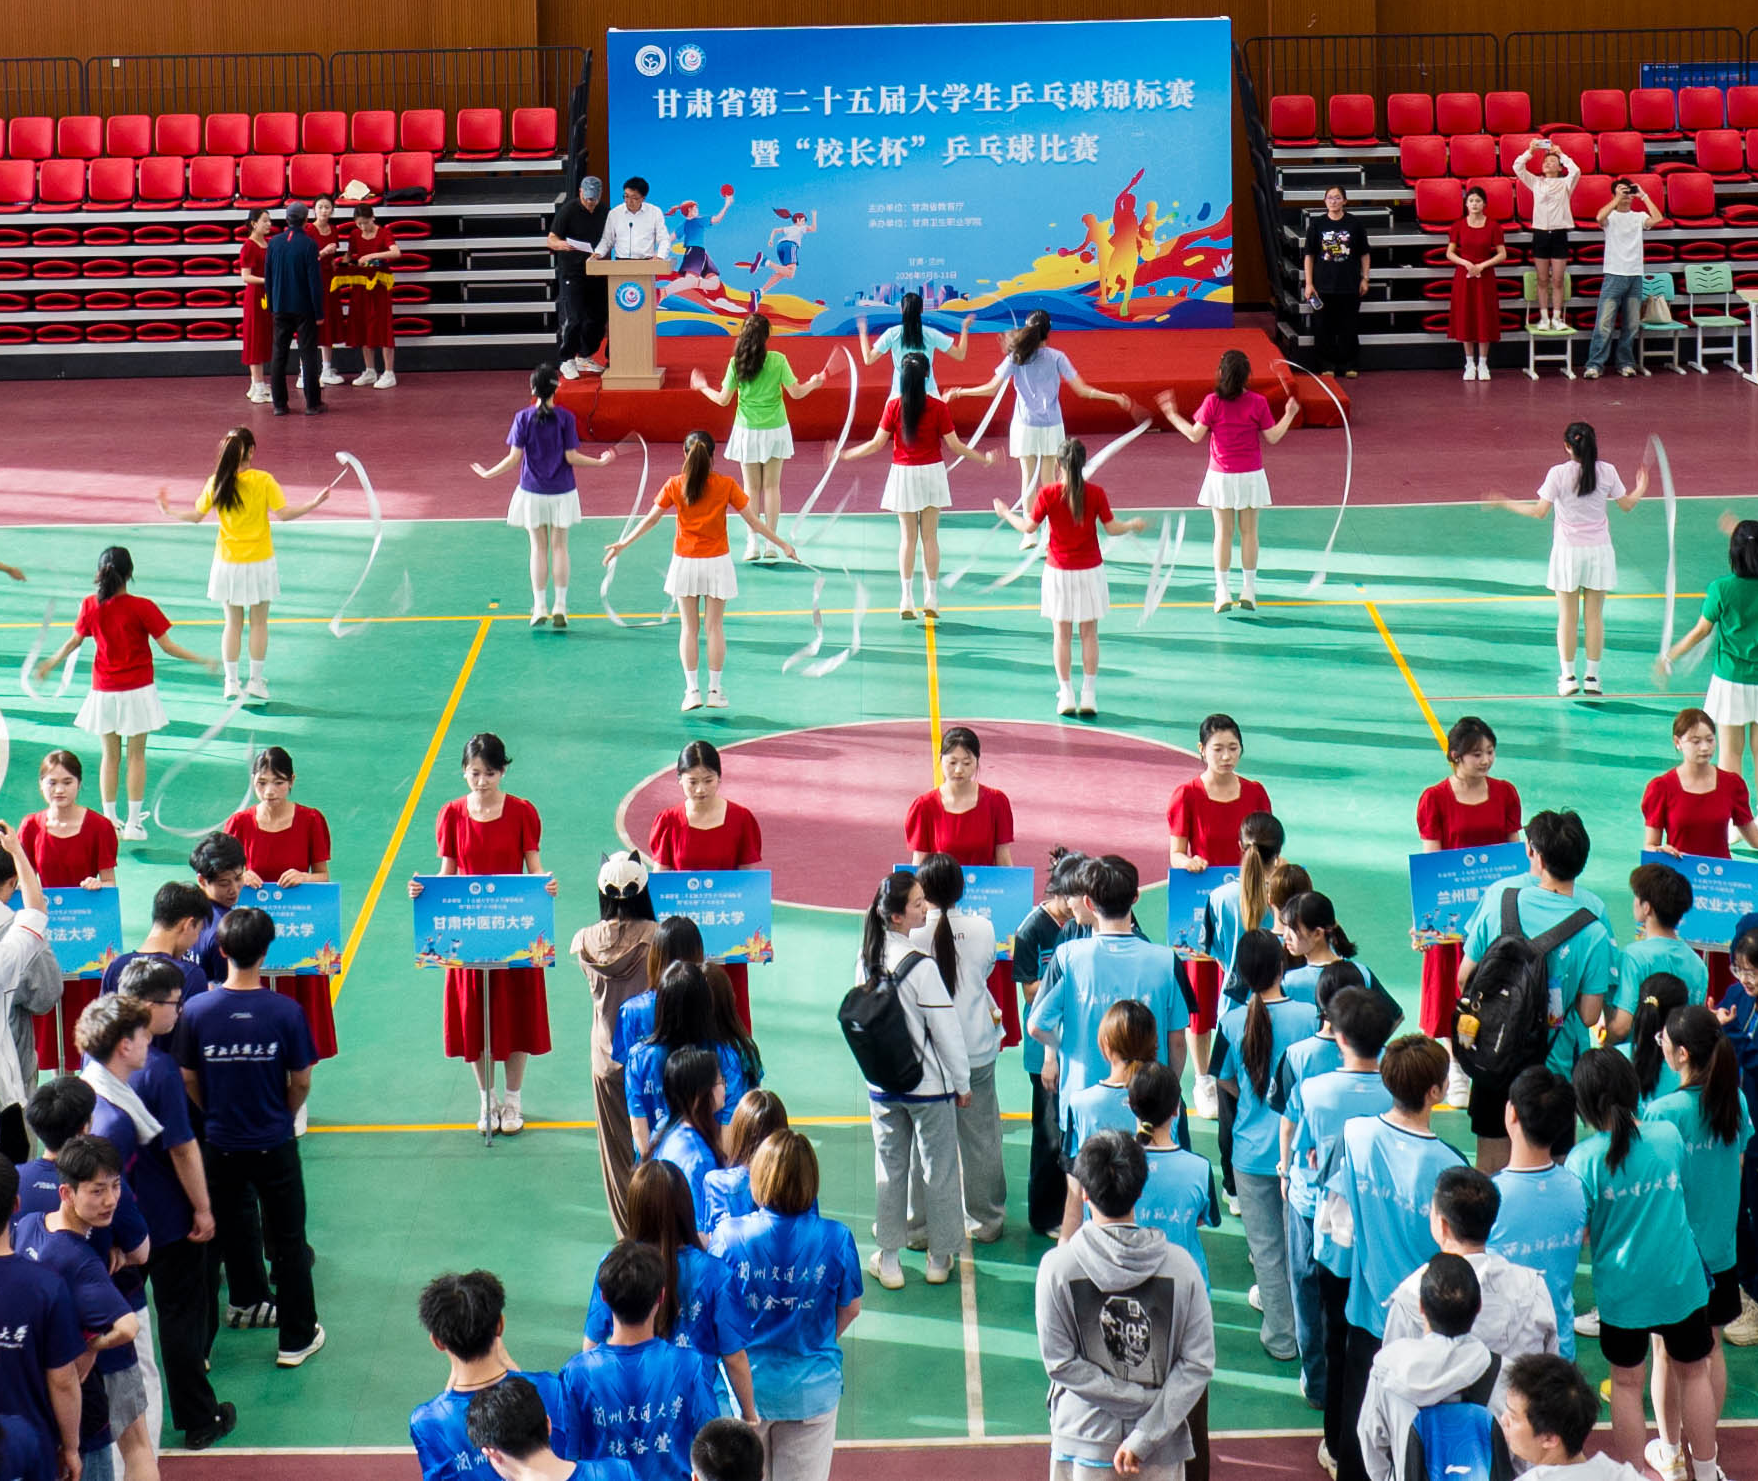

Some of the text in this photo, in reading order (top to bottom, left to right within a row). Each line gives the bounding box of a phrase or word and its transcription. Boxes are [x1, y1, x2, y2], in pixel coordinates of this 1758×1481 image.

[652, 78, 1196, 119] 甘肃省第二十五届大学生乒乓球锦标赛
[1694, 895, 1755, 915] 农业大学
[275, 922, 315, 938] 族大学
[433, 915, 535, 931] 甘肃中医药大学
[45, 926, 96, 942] 政法大学
